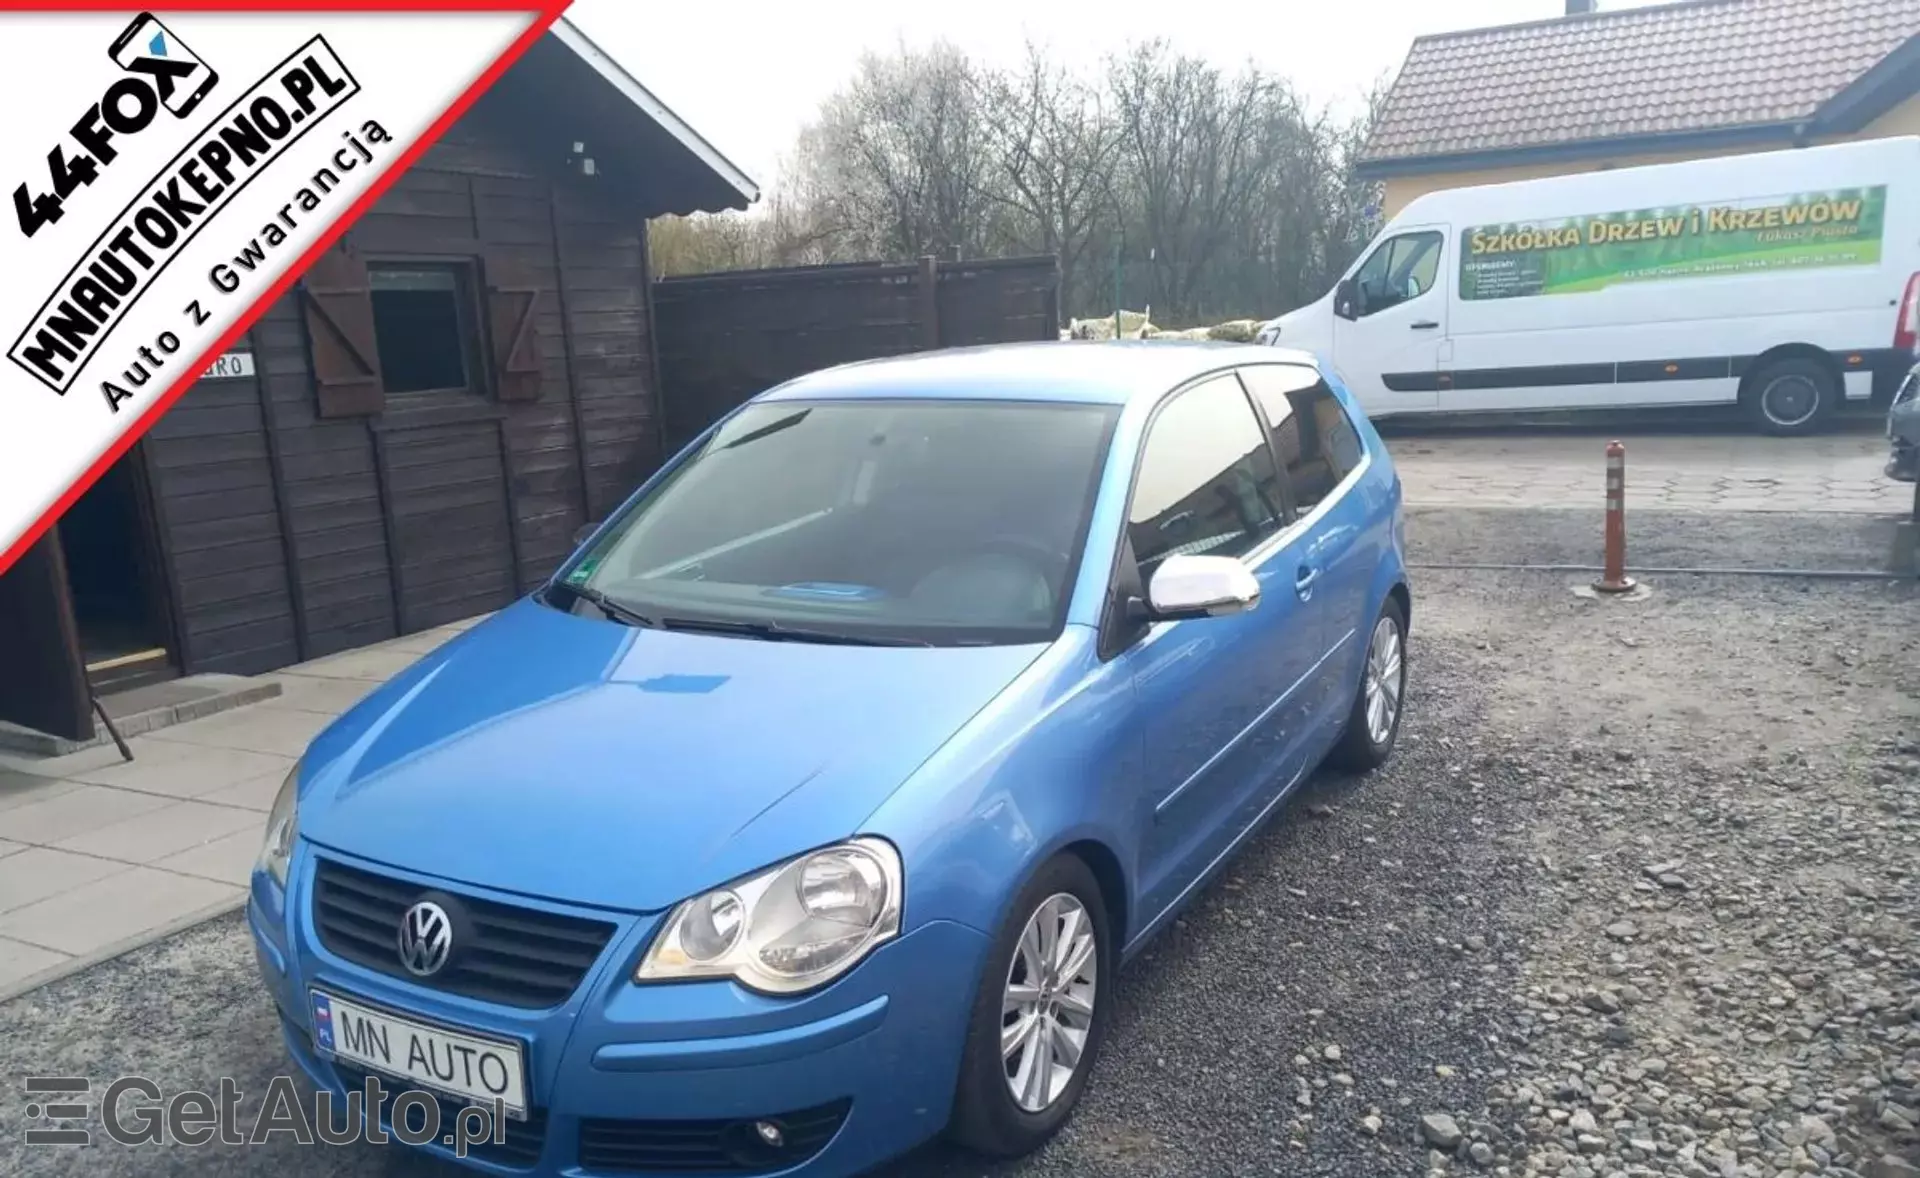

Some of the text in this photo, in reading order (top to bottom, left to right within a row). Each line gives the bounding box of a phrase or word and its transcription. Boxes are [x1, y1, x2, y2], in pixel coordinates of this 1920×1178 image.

[1588, 216, 1684, 244] DRZEW
[1691, 208, 1700, 234] i
[341, 1011, 508, 1094] MN AUTO
